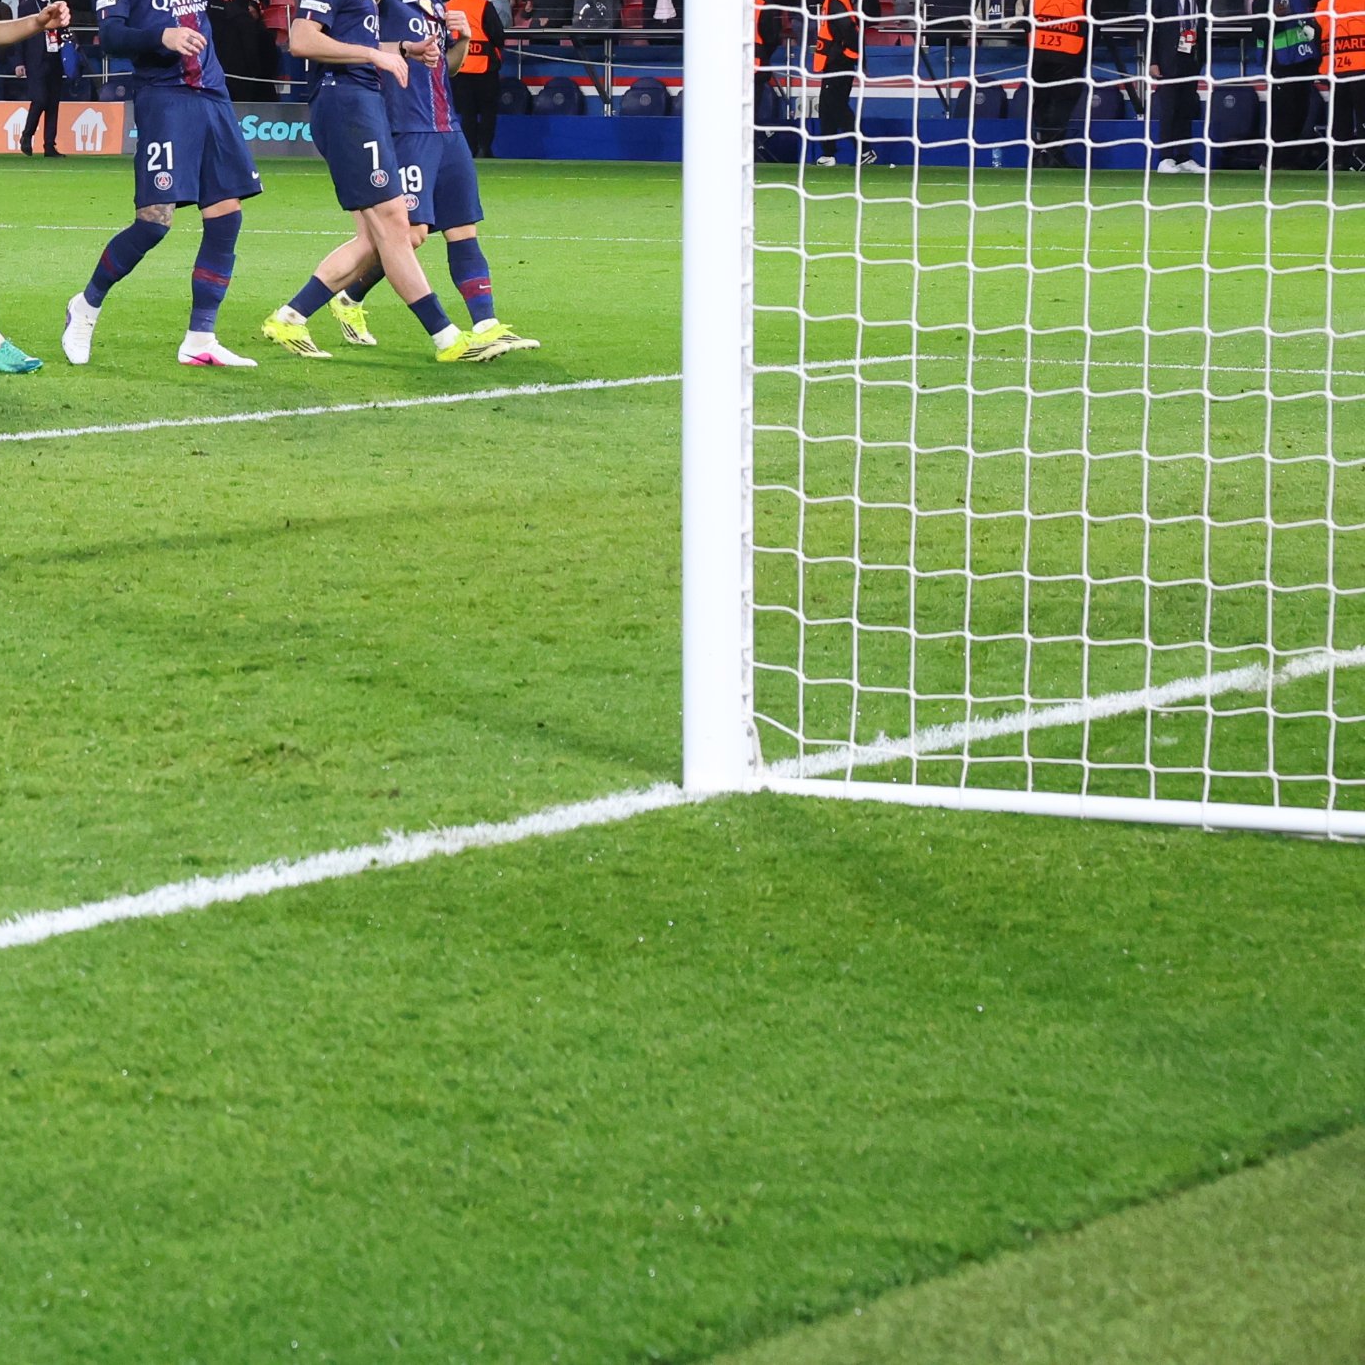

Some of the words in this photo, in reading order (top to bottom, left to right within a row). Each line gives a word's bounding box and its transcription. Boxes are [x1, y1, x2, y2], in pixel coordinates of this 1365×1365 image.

[1039, 34, 1062, 47] 123
[1298, 43, 1313, 57] 04
[147, 141, 174, 172] 21
[363, 141, 380, 171] 7
[398, 164, 423, 194] 19
